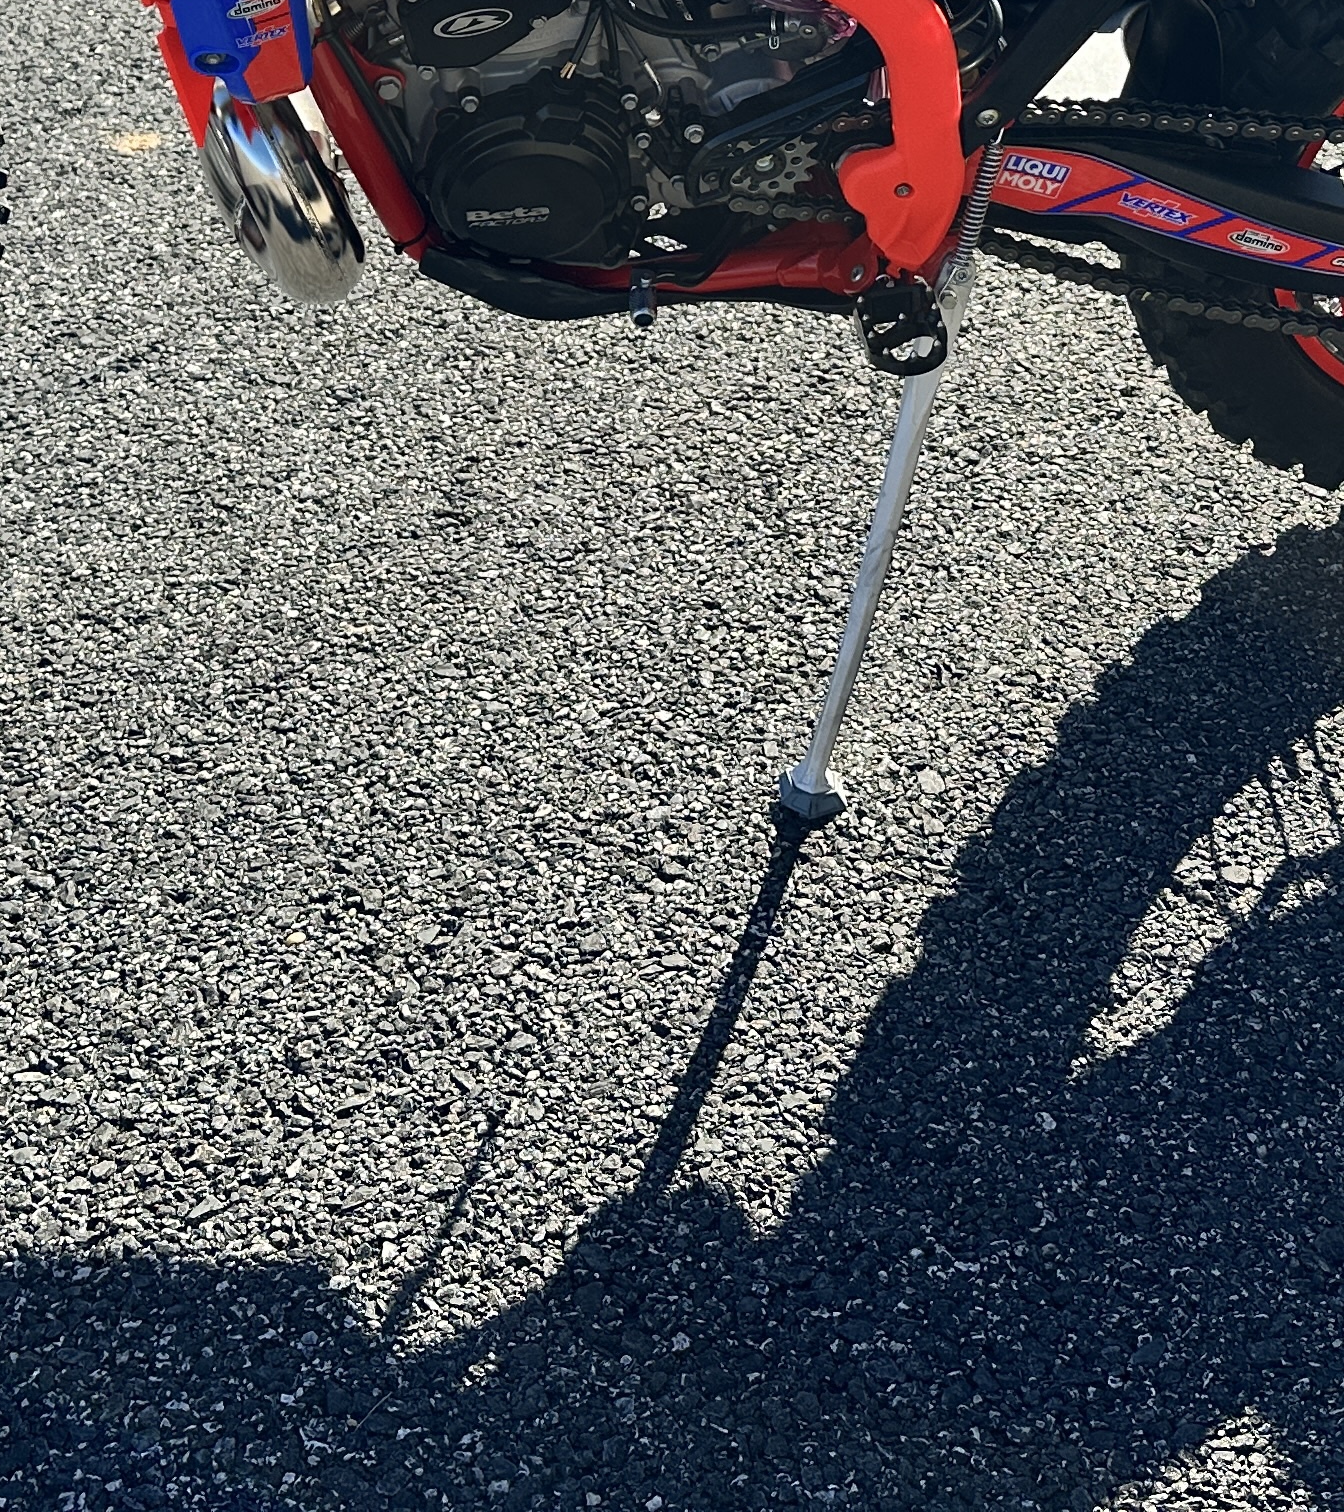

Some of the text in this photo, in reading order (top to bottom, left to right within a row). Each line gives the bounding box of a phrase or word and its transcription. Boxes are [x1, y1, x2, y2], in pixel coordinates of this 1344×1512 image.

[236, 25, 290, 48] VERTEX
[1007, 155, 1067, 182] LIQUI
[1001, 171, 1063, 196] MOLY
[466, 207, 550, 222] Beta
[1120, 192, 1194, 226] VERTEX
[468, 216, 549, 228] FACTORY
[1234, 231, 1284, 252] domino
